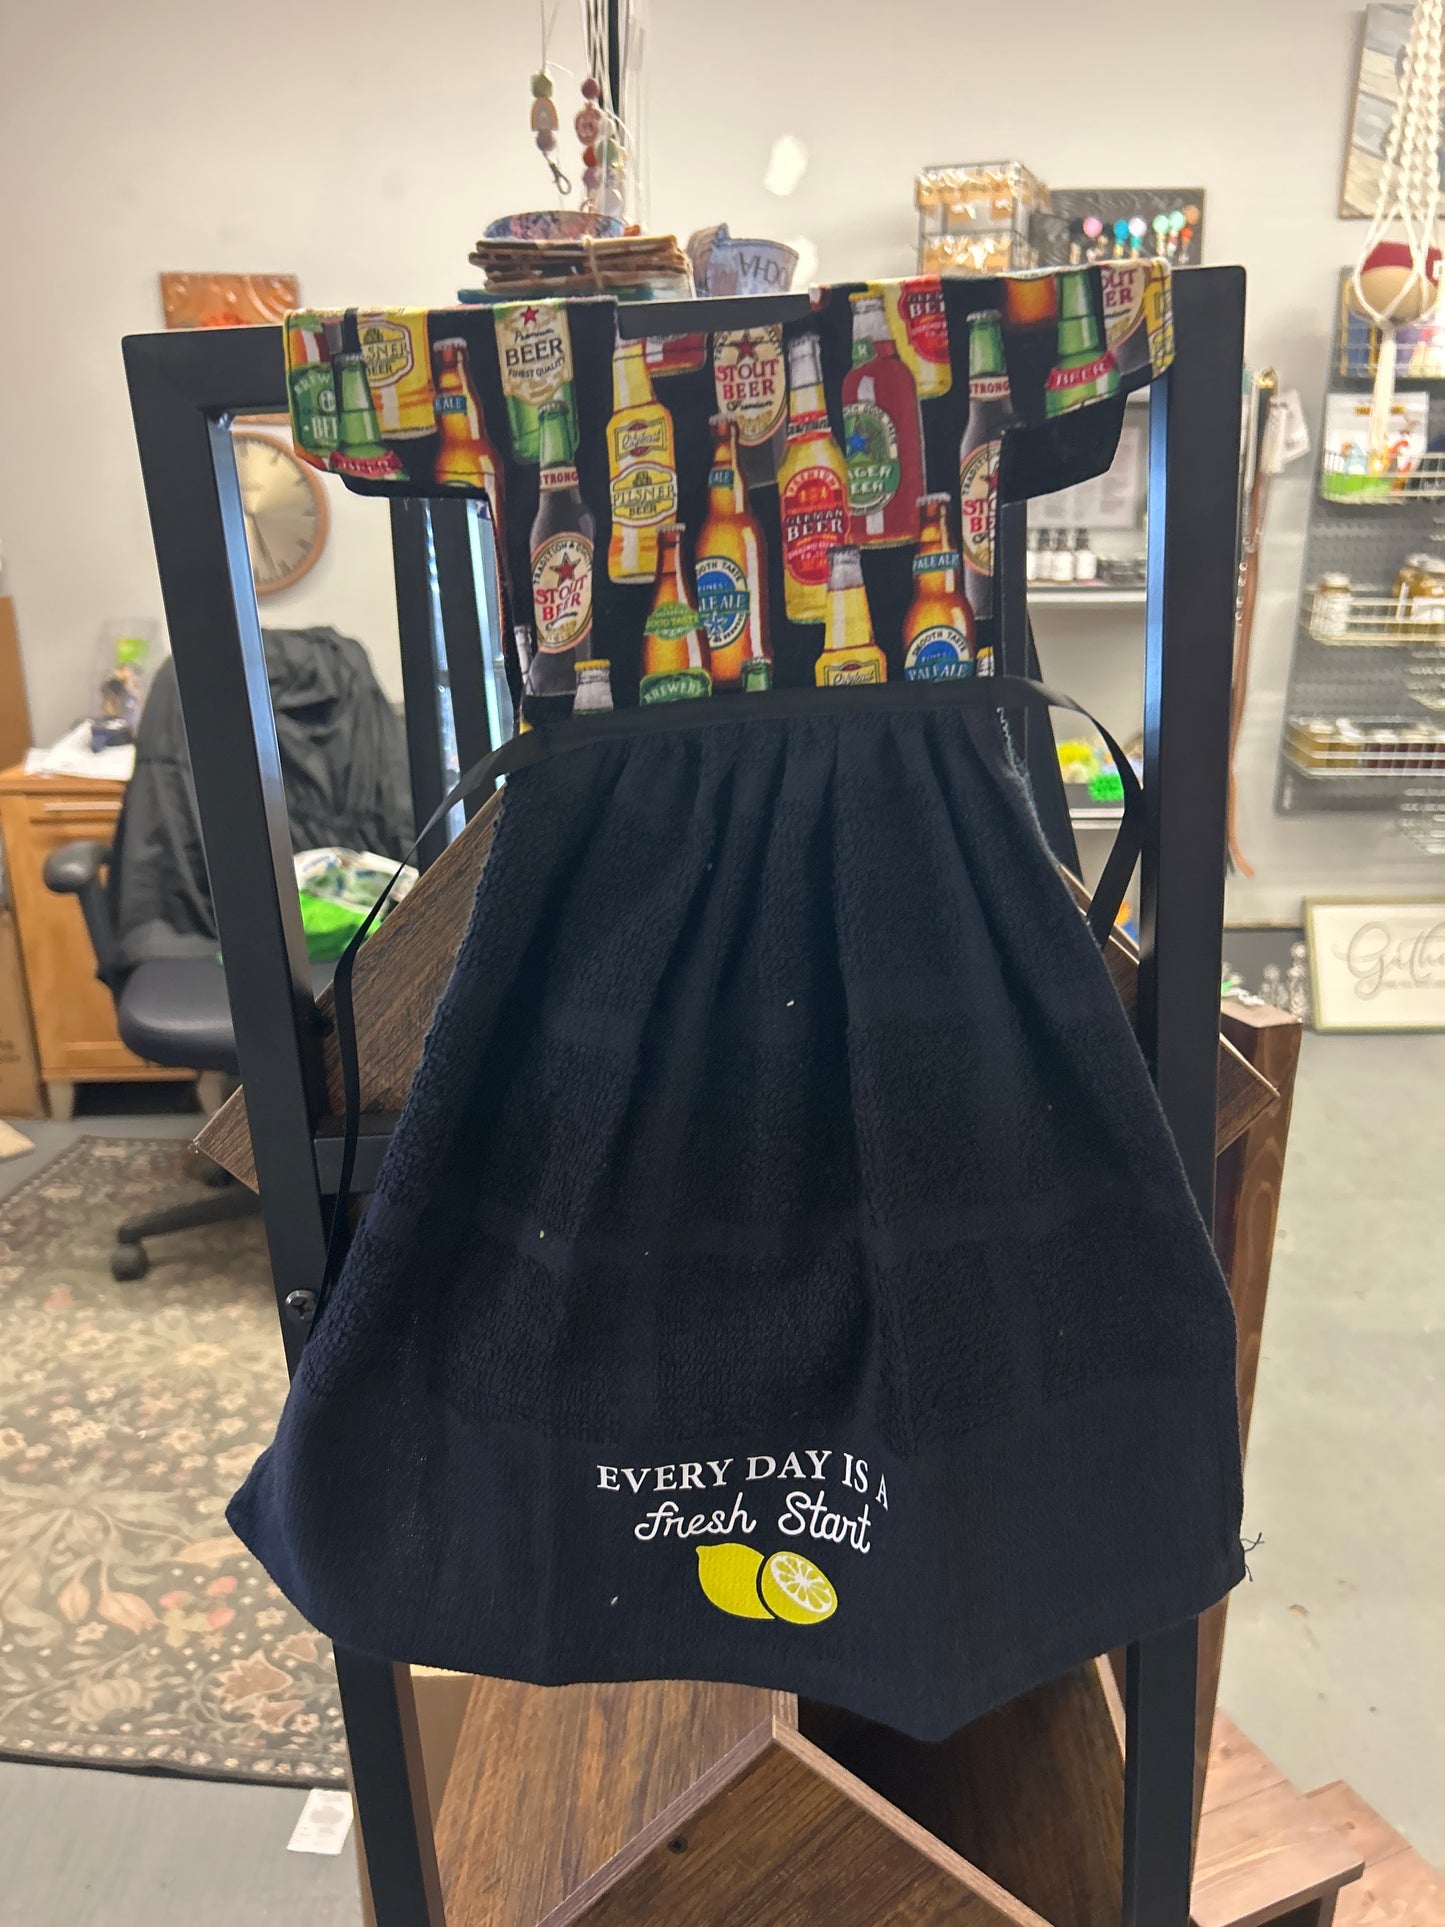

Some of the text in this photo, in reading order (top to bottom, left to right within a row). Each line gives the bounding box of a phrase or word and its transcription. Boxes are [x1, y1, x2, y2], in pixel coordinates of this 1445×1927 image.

[1103, 267, 1137, 289] OUT
[1105, 287, 1132, 308] ER
[505, 336, 564, 368] BEER
[508, 354, 566, 378] FINEST QUALITY
[715, 359, 780, 383] STOUT
[1055, 362, 1106, 387] BEER
[722, 378, 776, 401] BEER
[969, 379, 1009, 397] TRONG
[540, 470, 579, 486] TRONG
[850, 481, 885, 497] EER
[612, 484, 678, 506] PILSNER
[628, 504, 658, 517] BEER
[785, 508, 844, 526] GERMAN
[787, 518, 844, 543] BEER
[535, 574, 588, 605] STOUT
[719, 593, 746, 609] ALE
[542, 592, 582, 621] BEER
[911, 630, 943, 657] SMOOTH
[907, 660, 969, 683] PALE ALE
[597, 1450, 889, 1512] EVERY DAY IS A
[778, 1490, 872, 1554] Start
